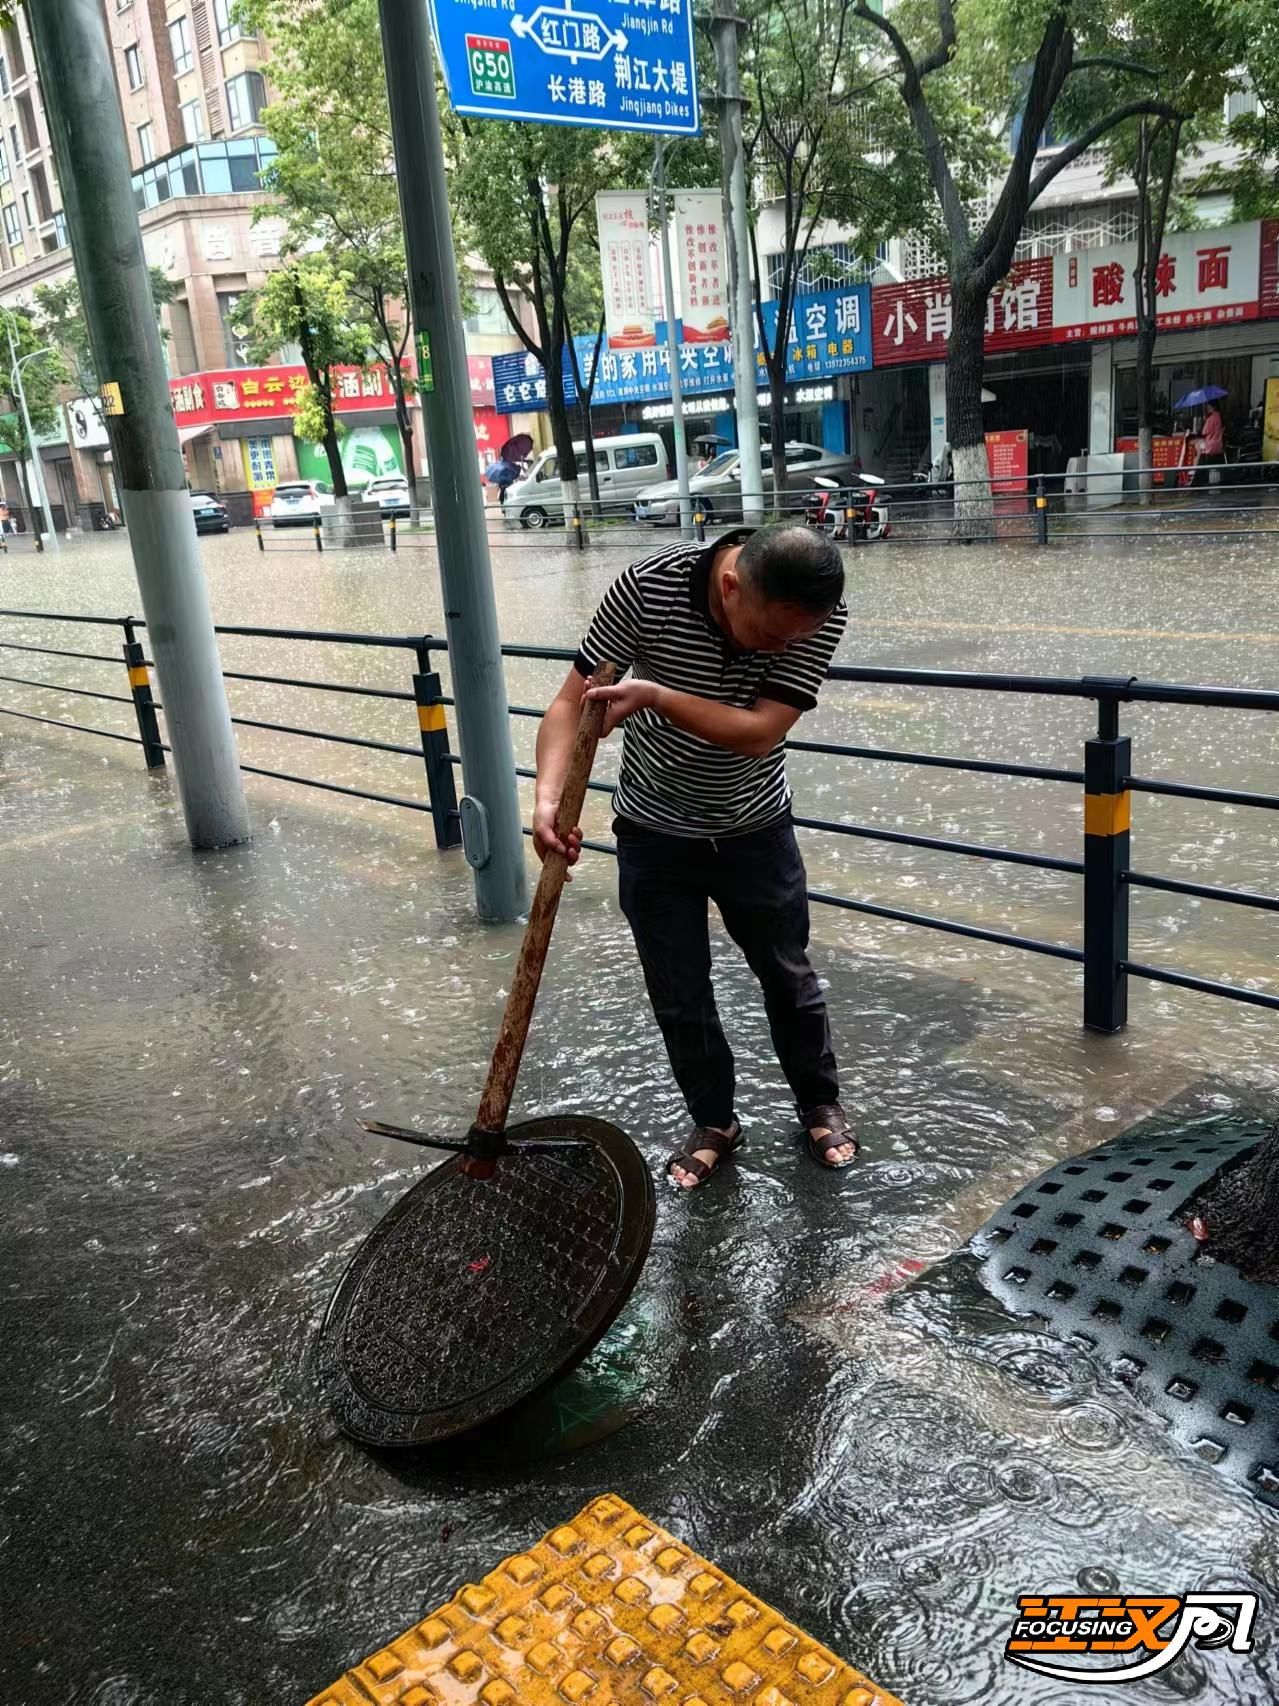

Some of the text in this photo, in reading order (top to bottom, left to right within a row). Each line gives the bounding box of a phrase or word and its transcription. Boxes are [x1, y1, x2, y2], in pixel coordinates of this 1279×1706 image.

[541, 17, 600, 51] 红门路
[621, 12, 674, 36] Jiangjin Rd
[472, 51, 510, 79] G50
[613, 53, 688, 95] 荆江大堤
[547, 74, 606, 108] 长港路
[620, 96, 689, 118] Jingjiang Dikes
[828, 339, 853, 356] 电器
